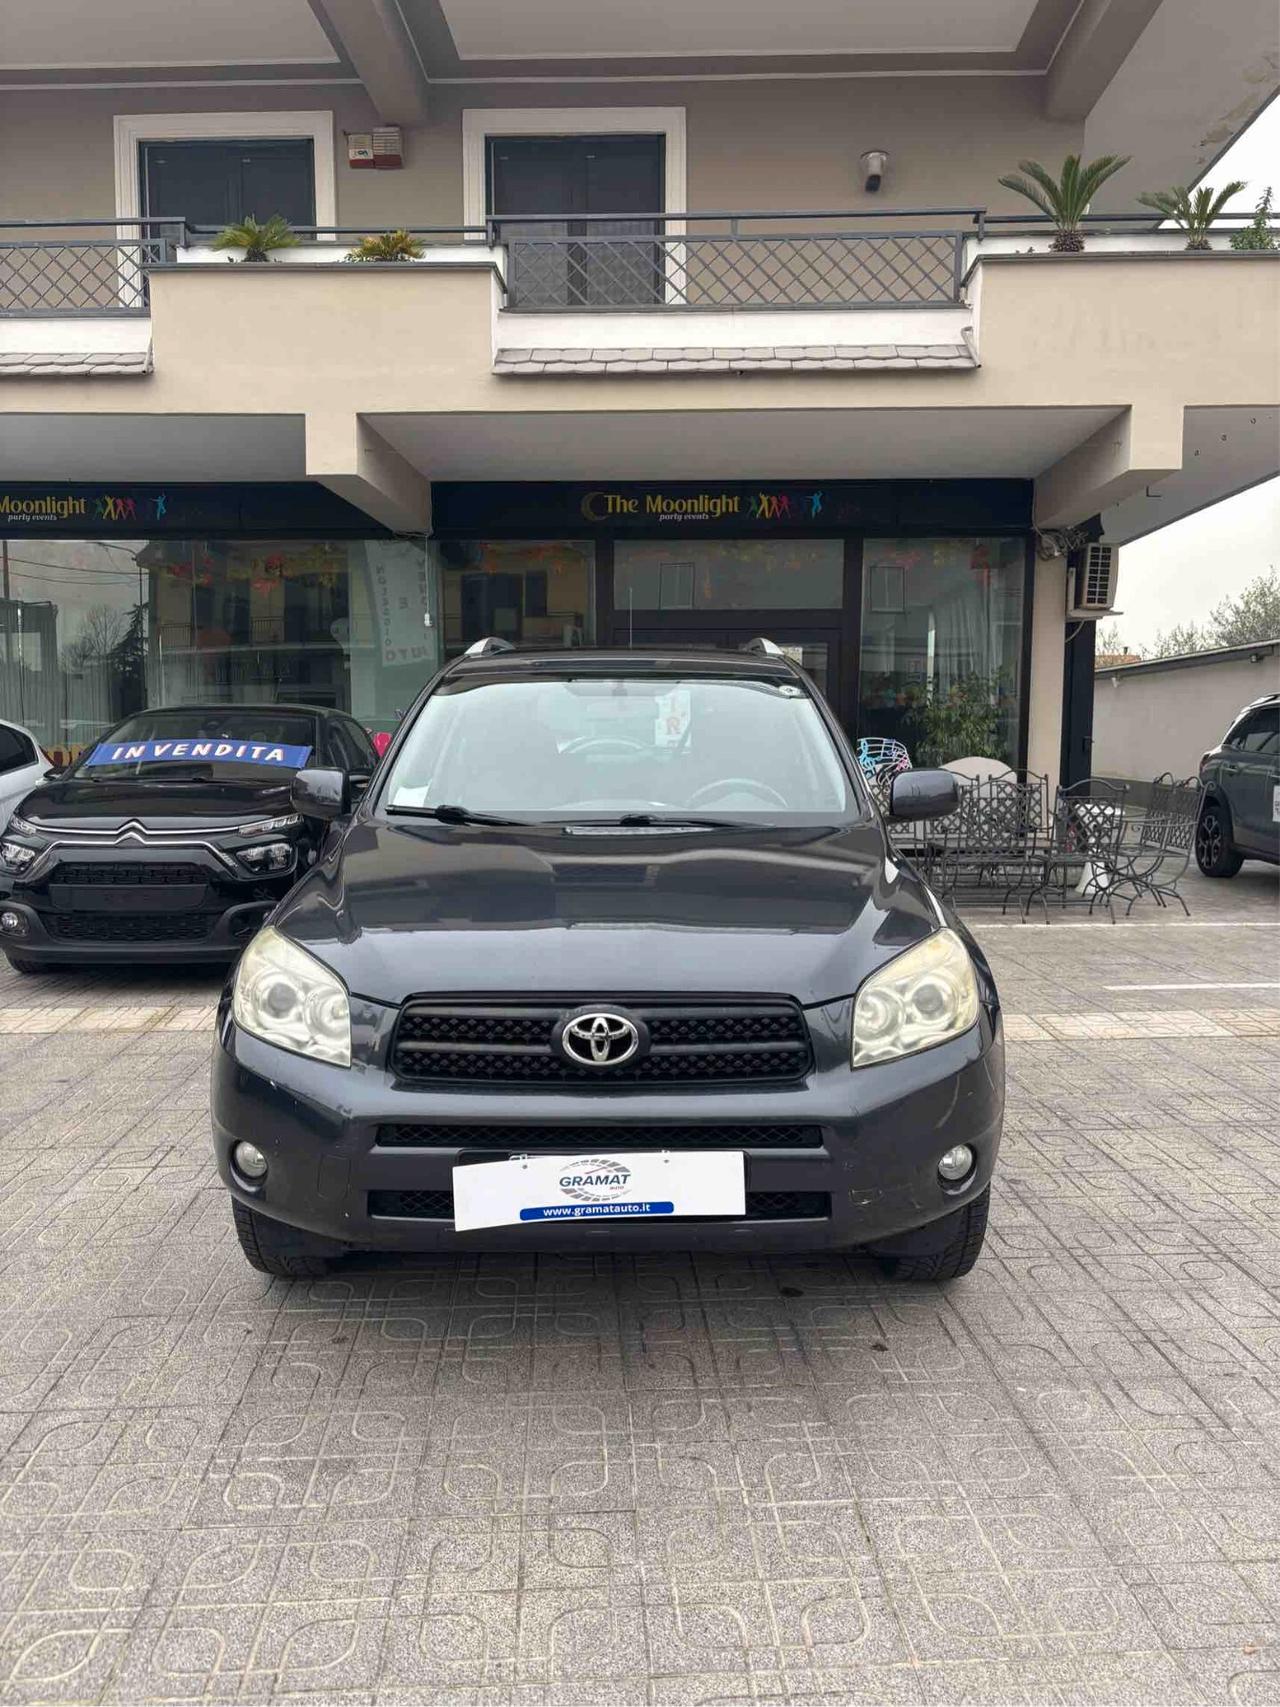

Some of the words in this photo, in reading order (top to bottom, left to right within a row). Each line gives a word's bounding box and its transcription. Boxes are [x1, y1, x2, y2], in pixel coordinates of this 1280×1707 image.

[603, 494, 640, 512] The
[646, 494, 741, 518] Moonlight
[7, 513, 31, 522] party
[32, 513, 58, 521] events
[658, 513, 683, 522] party
[684, 513, 709, 521] events
[111, 745, 146, 761] IN
[154, 743, 284, 762] VENDITA
[559, 1173, 631, 1188] GRAMAT
[543, 1202, 651, 1217] www.gramatauto.it
